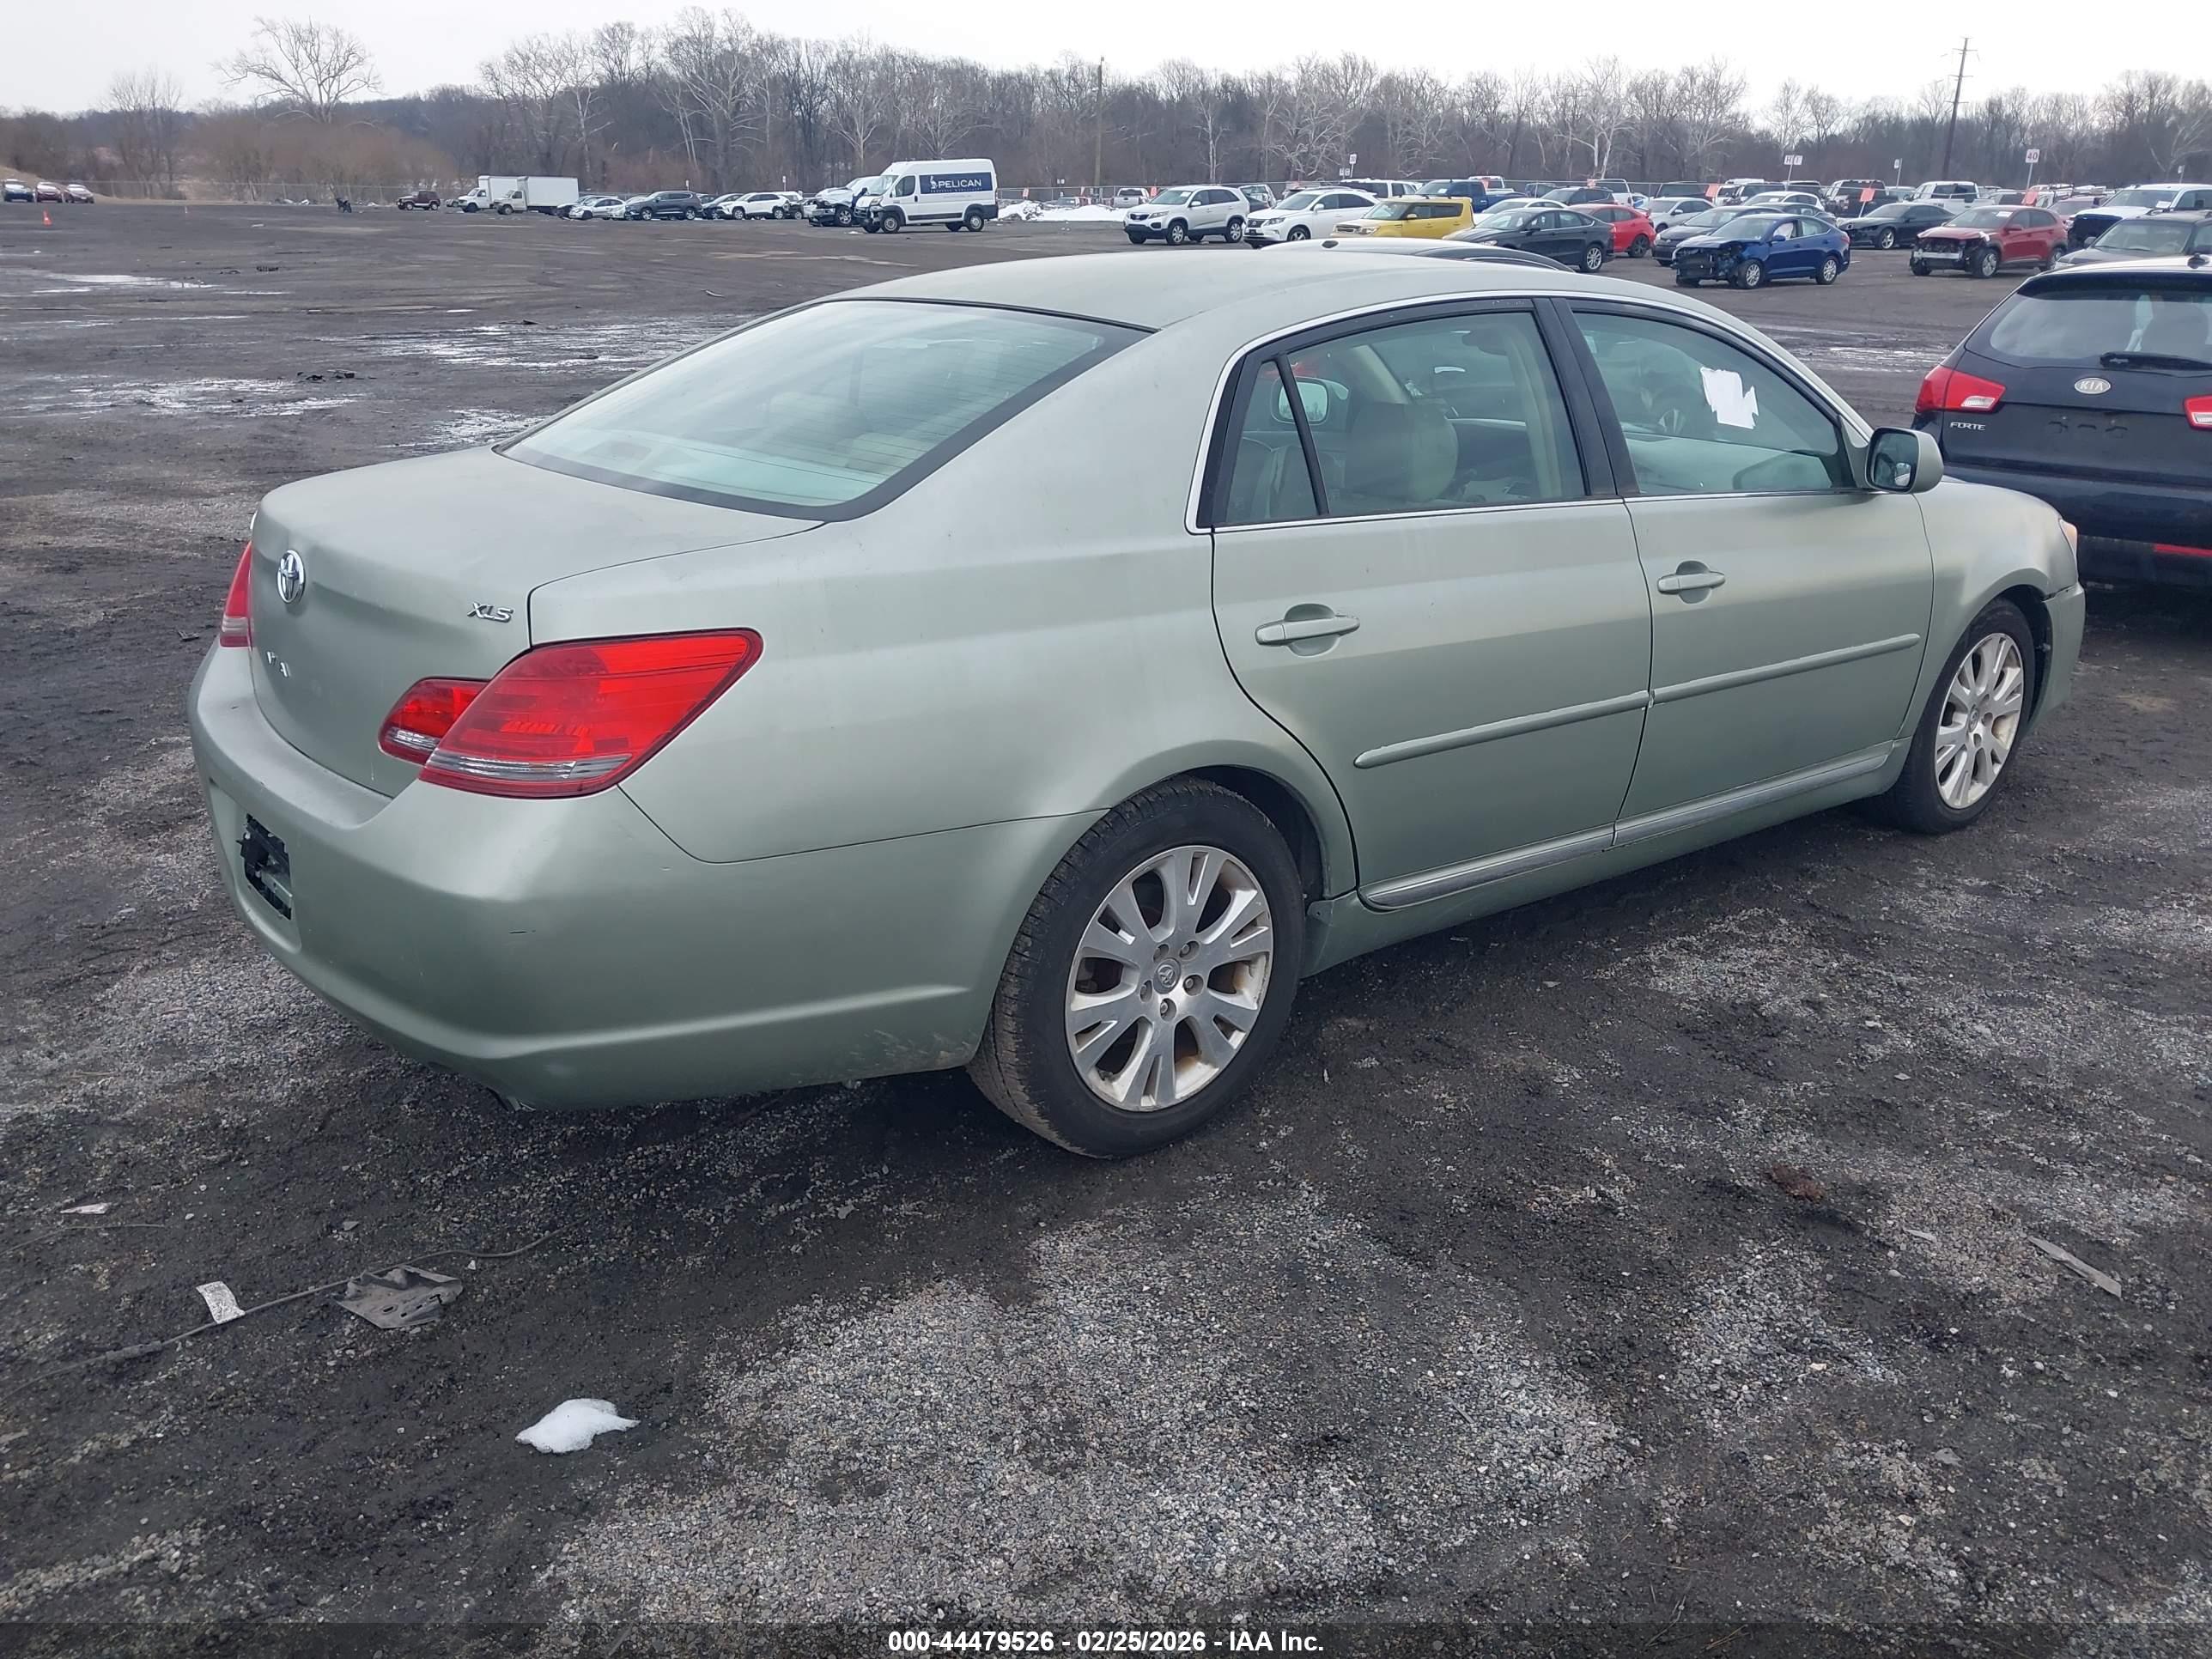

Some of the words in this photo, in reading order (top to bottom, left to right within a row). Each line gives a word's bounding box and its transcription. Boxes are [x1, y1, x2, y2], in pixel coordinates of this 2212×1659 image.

[2027, 152, 2038, 161] 40
[938, 179, 982, 189] PELICAN
[2079, 380, 2104, 392] KIA
[1949, 422, 1986, 431] FORTE
[467, 602, 514, 623] XLS
